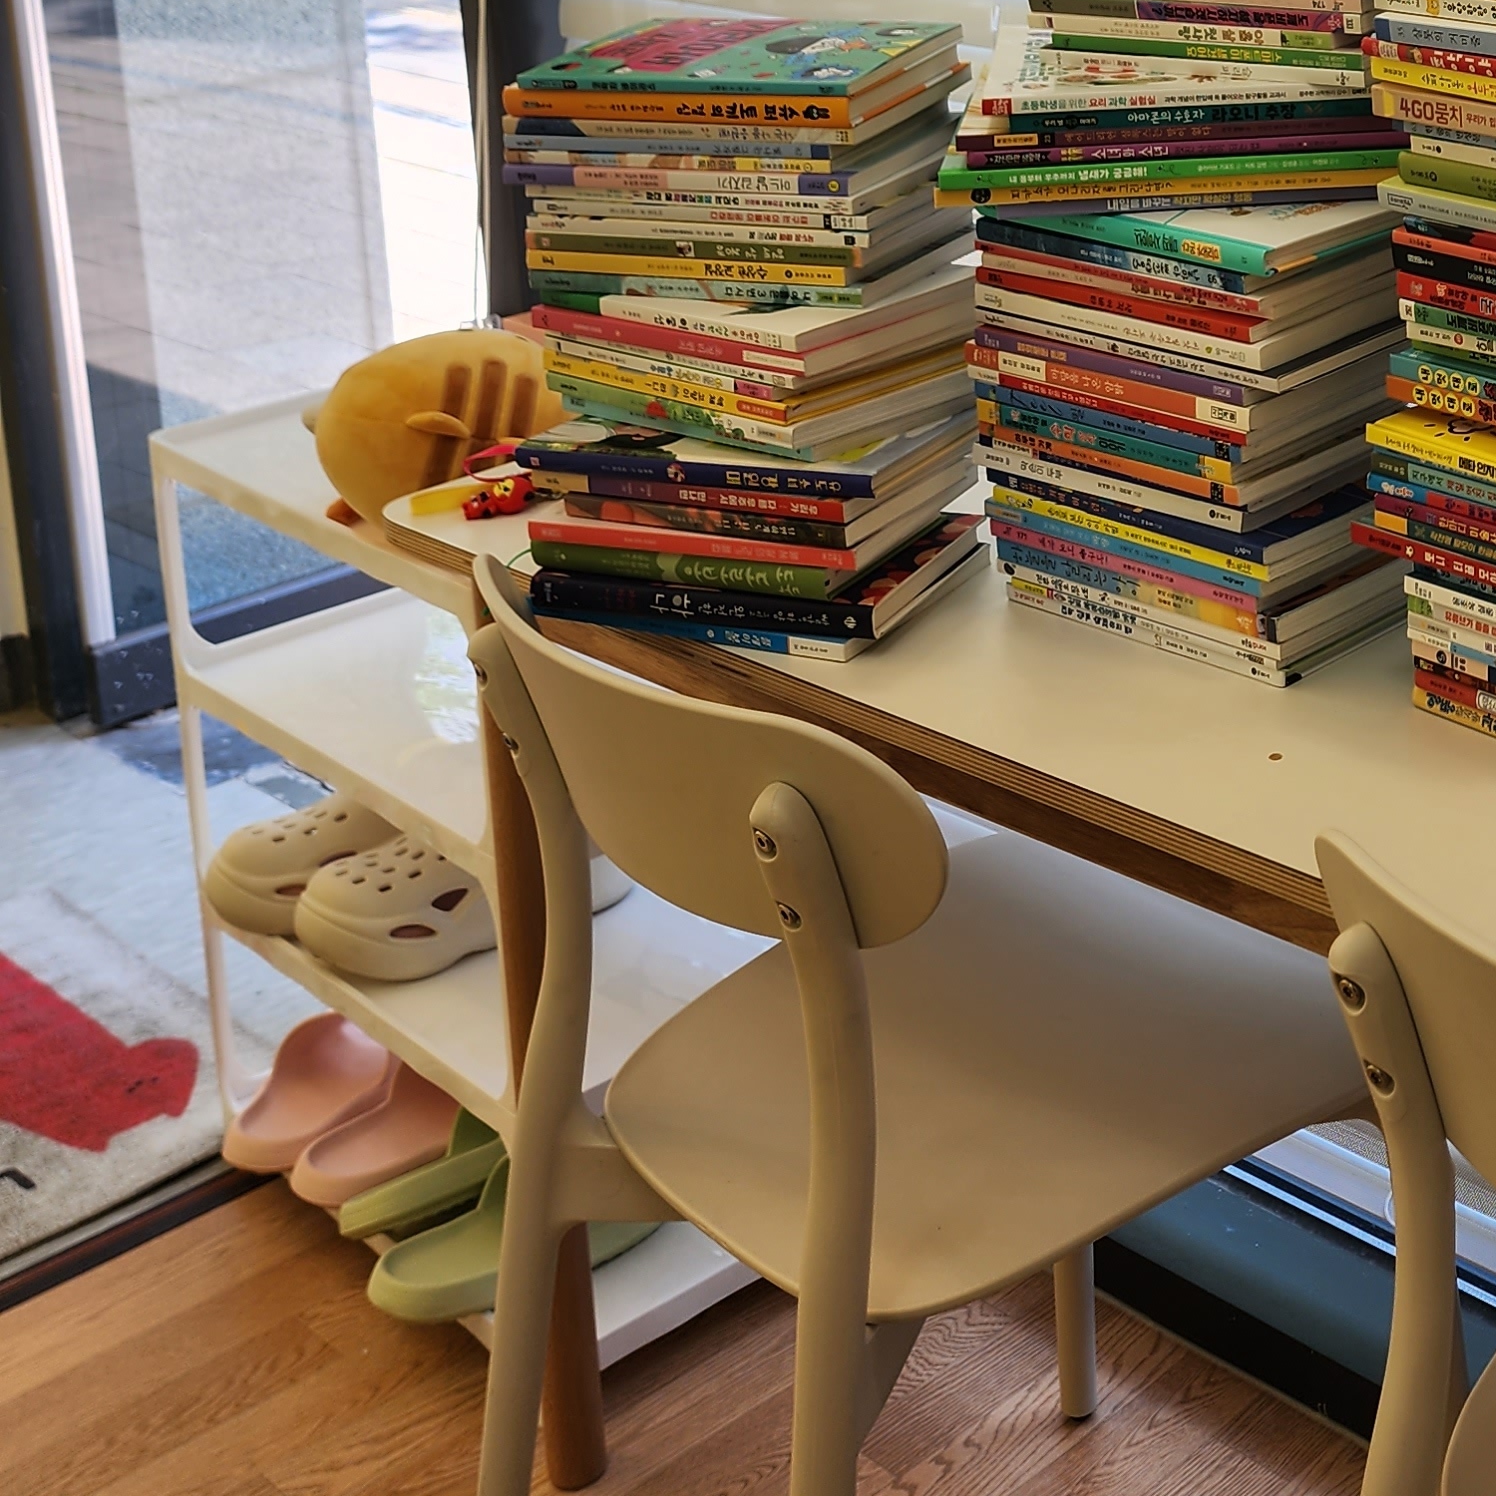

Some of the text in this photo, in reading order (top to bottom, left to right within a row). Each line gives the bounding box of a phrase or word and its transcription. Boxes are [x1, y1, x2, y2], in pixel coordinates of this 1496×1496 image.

[1442, 0, 1487, 18] 우당탕탕
[1177, 26, 1264, 45] 아홉 살 첫사랑
[1411, 28, 1481, 49] 샬롯의 거미줄
[1187, 46, 1282, 63] 스마트폰이 생겼어요
[675, 102, 706, 117] 결심
[710, 103, 757, 120] 토끼의
[762, 103, 800, 121] 슈퍼
[1021, 97, 1065, 111] 초등학생을
[1069, 98, 1086, 108] 위한
[1089, 98, 1107, 108] 요리
[1108, 97, 1126, 107] 과학
[1129, 95, 1157, 106] 실험실
[1399, 92, 1464, 129] 4GO뭉치
[1466, 112, 1488, 127] 우리가
[1128, 105, 1296, 125] 아마존의 수호자 라오니 추장
[1091, 146, 1169, 160] 소녀와 소년
[716, 175, 791, 192] 어느날 갑자기
[1009, 175, 1018, 183] 내
[1078, 168, 1110, 181] 냄새가
[1112, 166, 1148, 179] 궁금해!
[1009, 187, 1051, 200] 피카소가
[1106, 198, 1140, 210] 내일을
[1142, 196, 1171, 208] 바꾸는
[704, 262, 768, 280] 수상한 교장실
[1051, 367, 1081, 385] 마당을
[1083, 375, 1102, 389] 나온
[1104, 381, 1125, 396] 암탉
[1418, 366, 1434, 383] 내
[1434, 370, 1479, 396] 멋대로
[1413, 385, 1428, 402] 내
[1429, 389, 1475, 416] 멋대로
[786, 475, 843, 494] 유도 소녀
[718, 494, 755, 508] 우주에서
[790, 501, 819, 516] 우리가
[1058, 542, 1075, 557] 오니
[650, 592, 695, 618] 하나
[699, 602, 747, 620] 완전한
